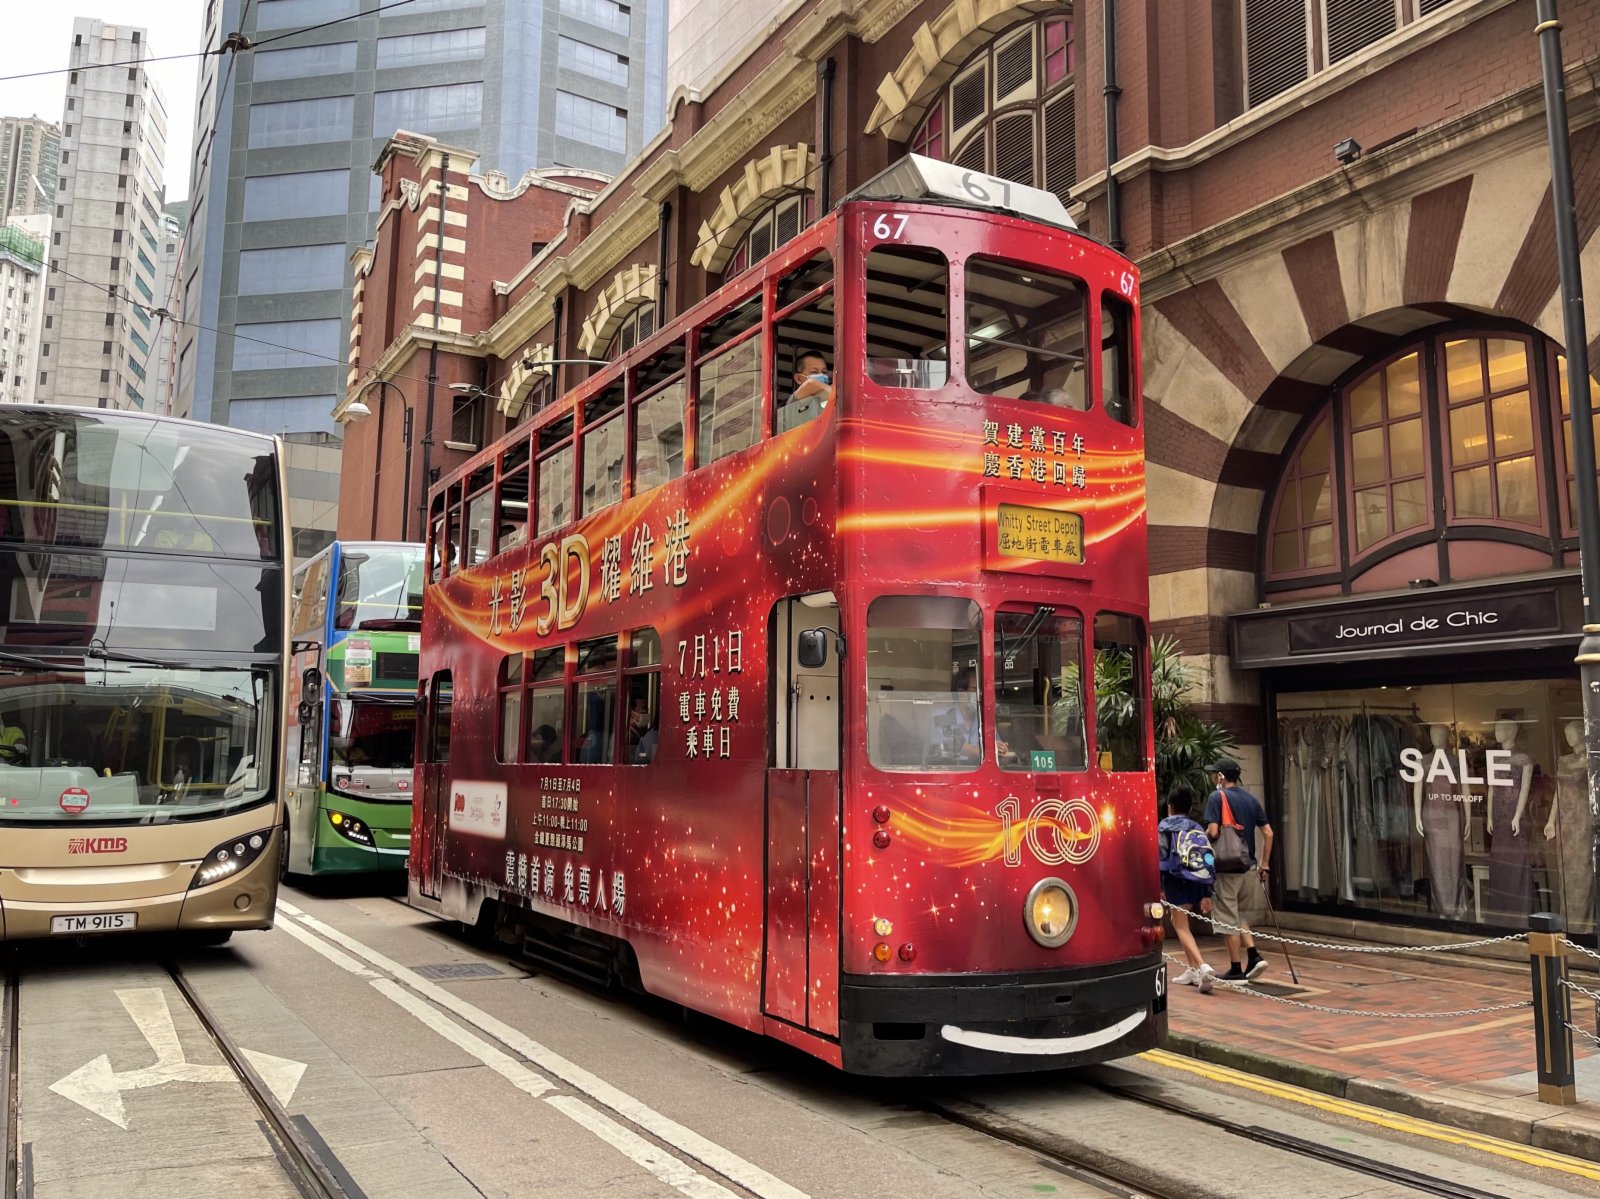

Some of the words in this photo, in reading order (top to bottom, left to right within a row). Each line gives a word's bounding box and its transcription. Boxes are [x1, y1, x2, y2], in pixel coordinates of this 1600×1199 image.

[961, 172, 1011, 208] 67
[873, 213, 910, 240] 67
[1120, 271, 1134, 296] 67
[982, 418, 1086, 460] 賀建黨百年
[983, 450, 1086, 490] 慶香港回歸
[998, 511, 1023, 533] Whitty
[1026, 514, 1051, 533] Street
[1054, 517, 1078, 537] Depot
[998, 532, 1078, 557] 屈地街電車廠
[486, 567, 527, 640] 光影
[536, 533, 590, 638] 3D
[600, 507, 691, 605] 耀維港
[1335, 618, 1403, 639] Journal
[1410, 616, 1440, 631] de
[1446, 611, 1499, 627] Chic
[678, 629, 742, 680] 7月1日
[679, 686, 740, 722] 電車免費
[686, 725, 730, 759] 乘車日
[1034, 755, 1054, 769] 105
[1399, 747, 1514, 787] SALE
[1428, 793, 1439, 801] UP
[1440, 793, 1452, 801] TO
[85, 837, 128, 854] KMB
[995, 796, 1101, 868] 100
[65, 917, 87, 931] TM
[93, 915, 124, 929] 9115
[1155, 967, 1166, 997] 67
